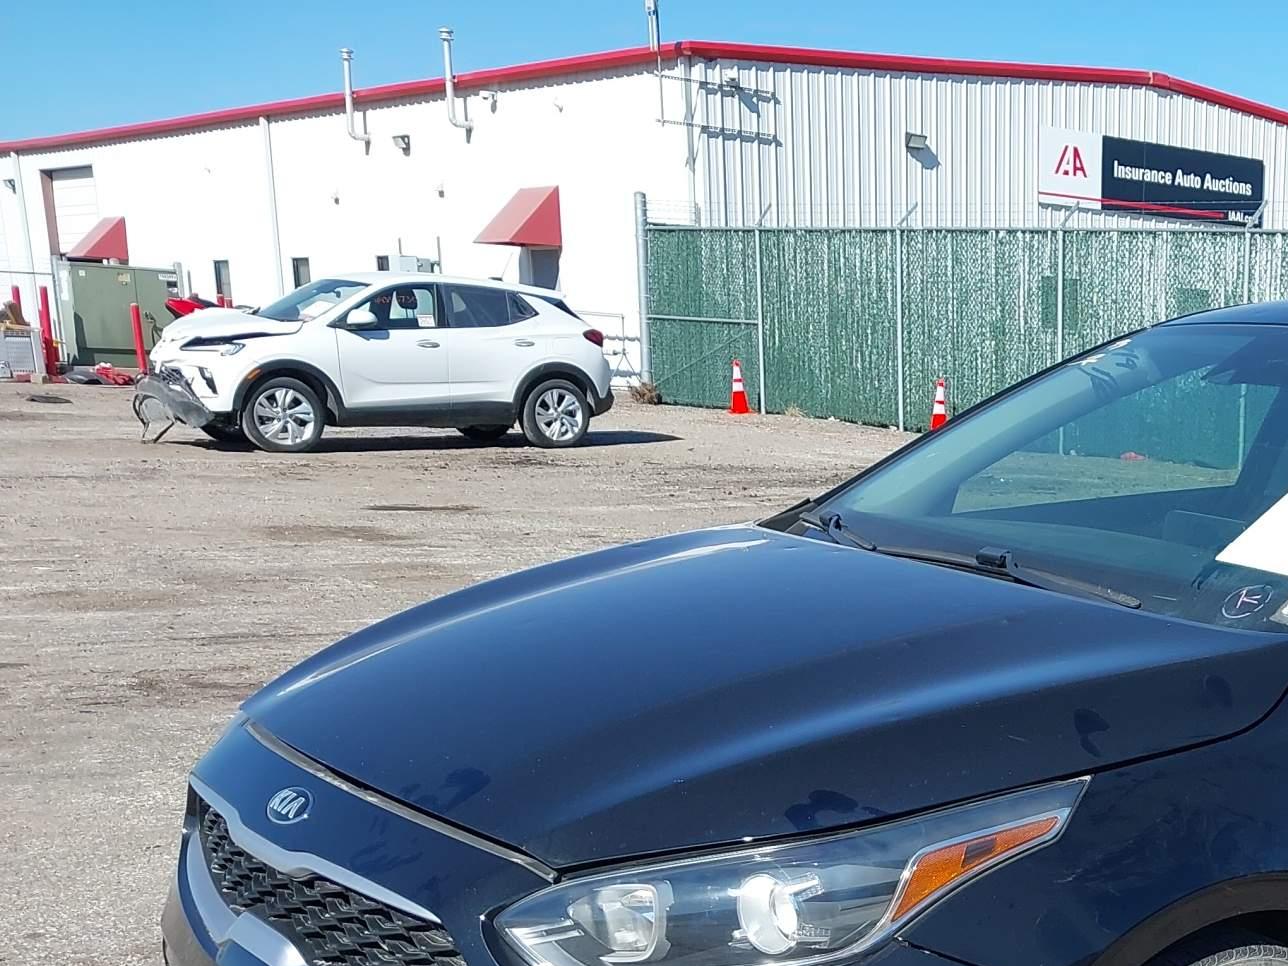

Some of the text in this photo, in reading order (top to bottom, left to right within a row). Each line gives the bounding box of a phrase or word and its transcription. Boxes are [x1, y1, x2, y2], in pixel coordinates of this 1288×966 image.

[1113, 159, 1253, 196] Insurance Auto Auctions
